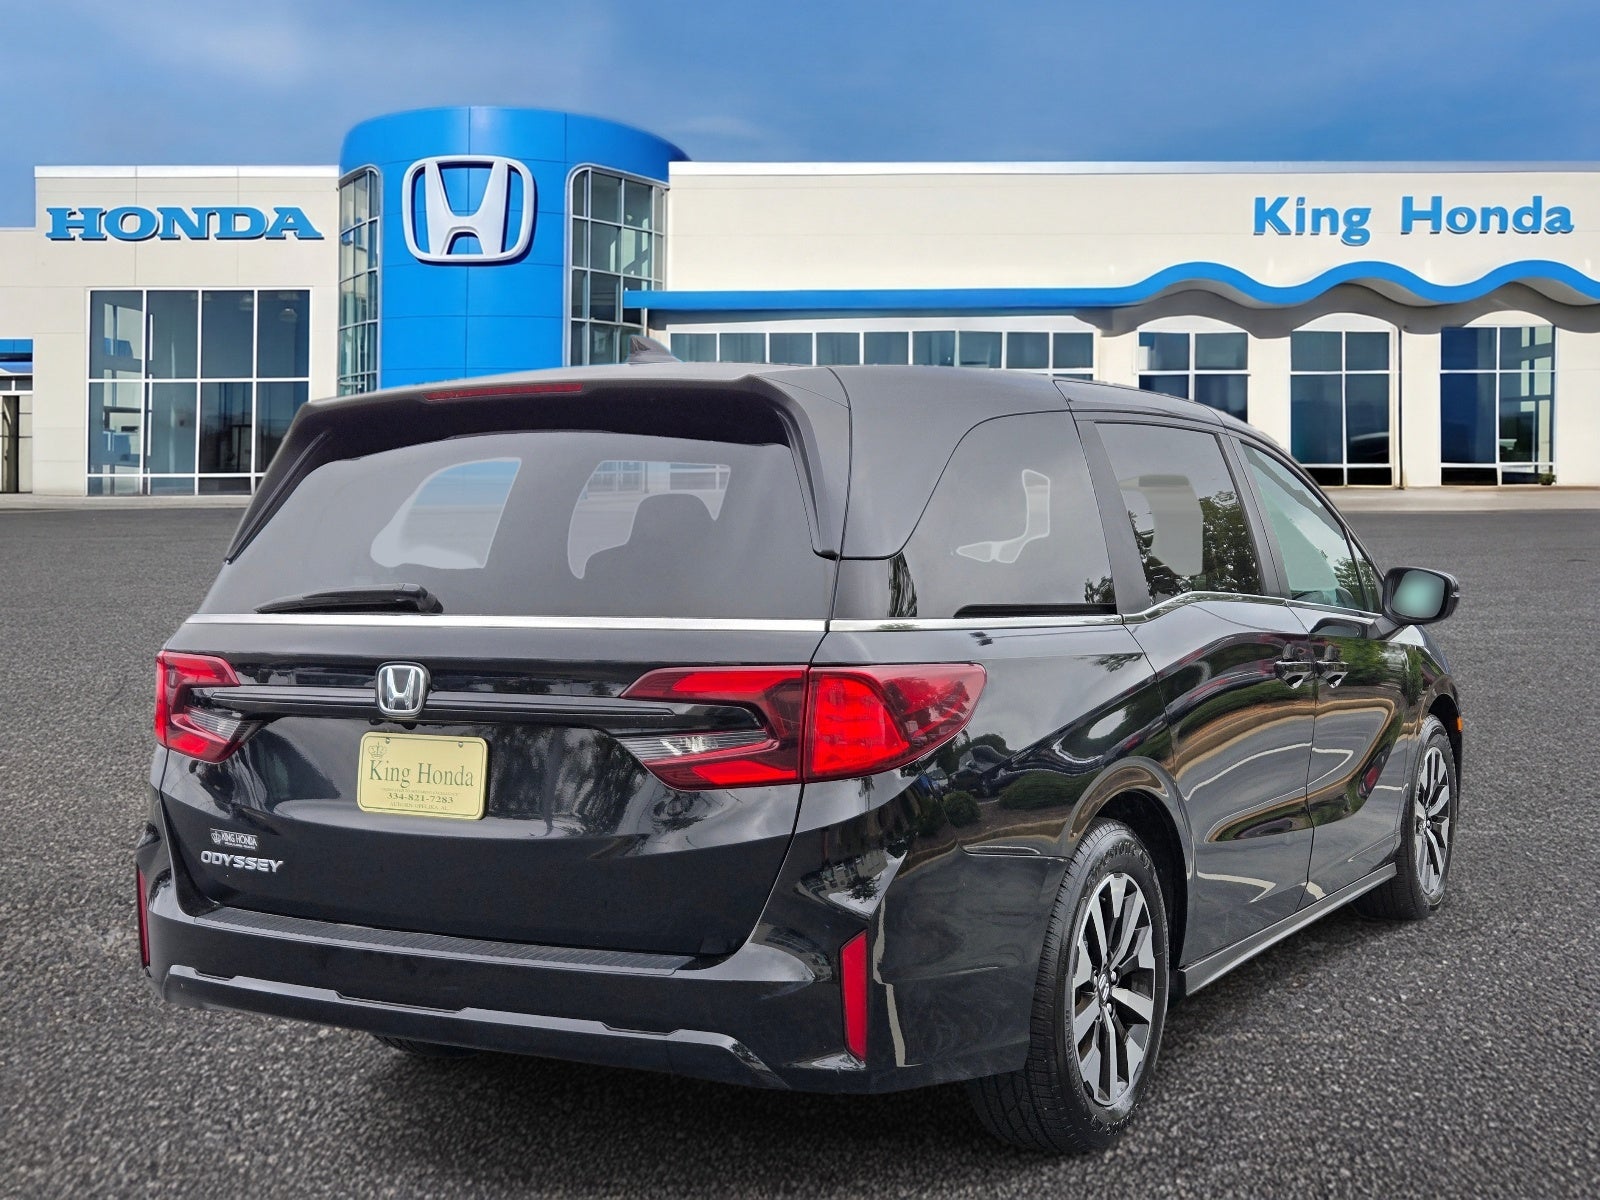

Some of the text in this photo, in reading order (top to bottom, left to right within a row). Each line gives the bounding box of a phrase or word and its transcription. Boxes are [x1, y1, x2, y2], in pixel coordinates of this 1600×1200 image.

[45, 206, 325, 241] HONDA
[1253, 195, 1575, 246] King Honda
[369, 759, 474, 788] King Honda
[386, 792, 454, 804] 334-821-7283
[200, 850, 284, 873] ODYSSEY
